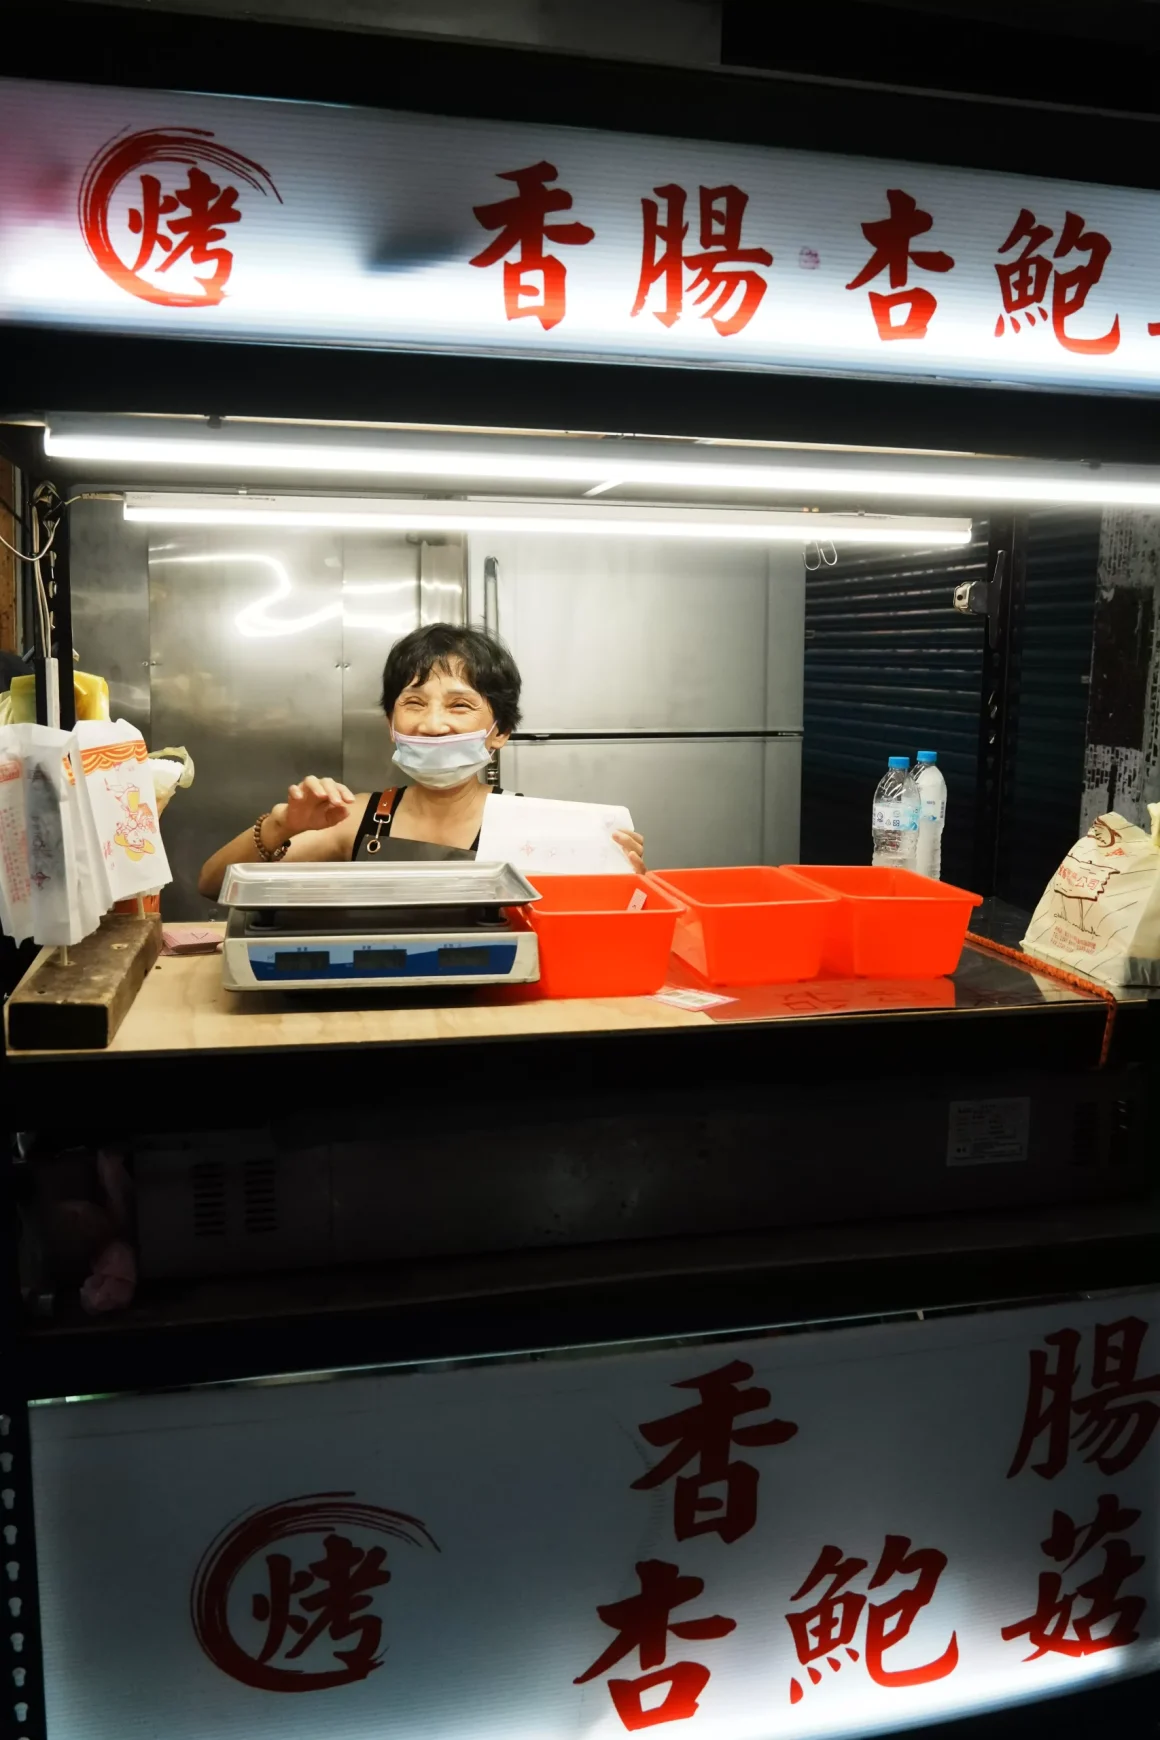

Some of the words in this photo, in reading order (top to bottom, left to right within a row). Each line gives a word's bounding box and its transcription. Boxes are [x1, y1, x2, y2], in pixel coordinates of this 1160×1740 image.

[128, 167, 242, 298] 烤
[469, 161, 773, 336] 香腸
[846, 189, 1160, 355] 杏鮑
[252, 1534, 392, 1672] 烤
[573, 1494, 1148, 1732] 杏鮑菇
